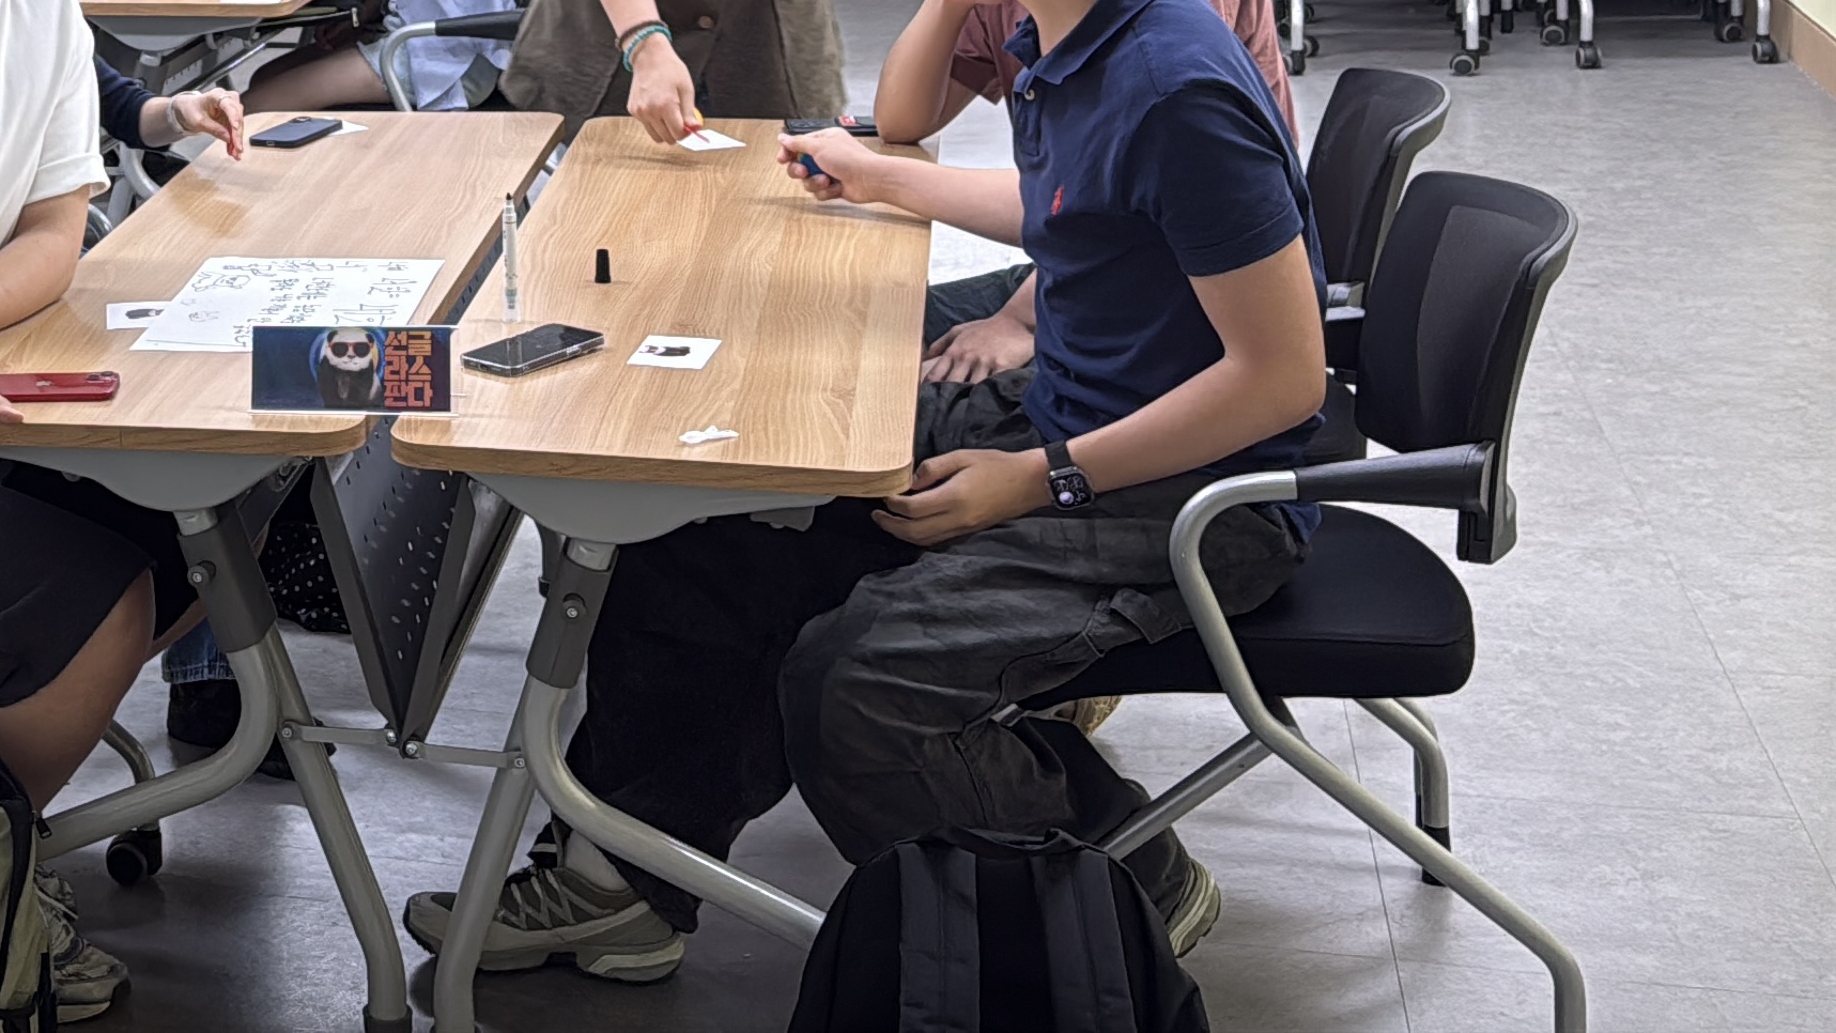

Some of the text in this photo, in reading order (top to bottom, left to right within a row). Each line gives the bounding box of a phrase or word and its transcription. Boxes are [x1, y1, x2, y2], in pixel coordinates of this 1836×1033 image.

[384, 331, 432, 355] 선글
[384, 355, 432, 380] 라스
[383, 381, 434, 407] 판다
